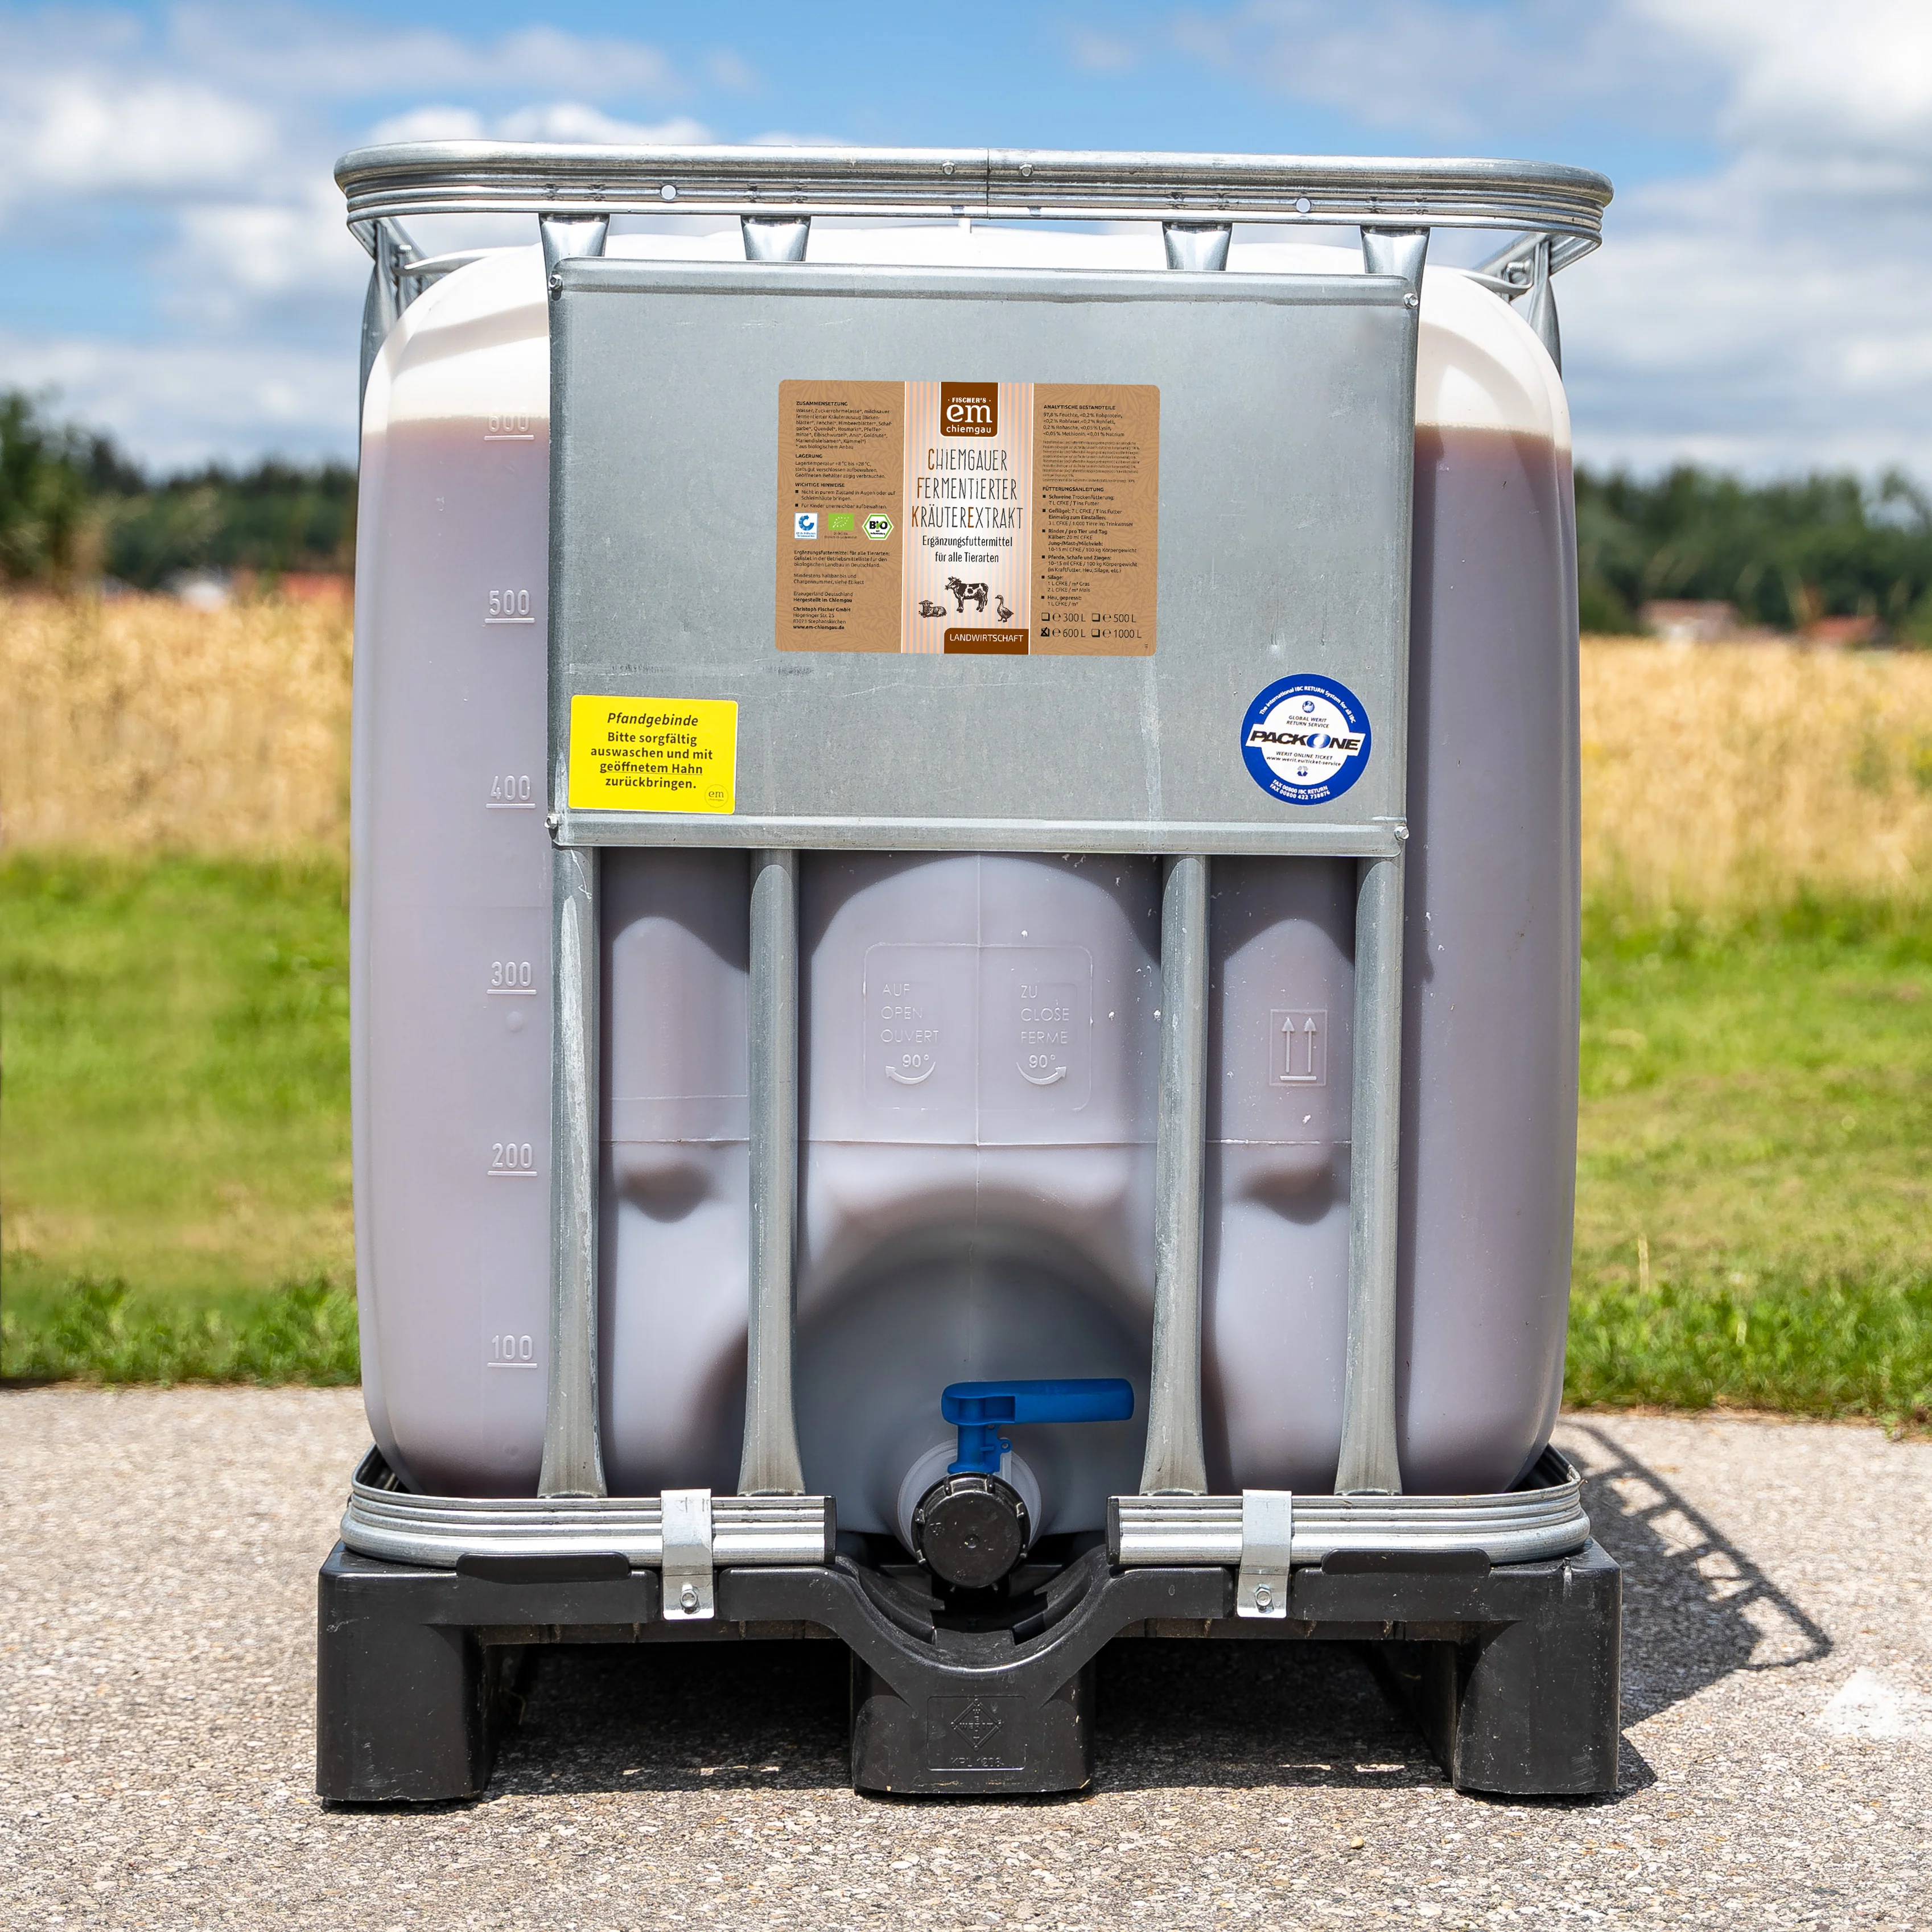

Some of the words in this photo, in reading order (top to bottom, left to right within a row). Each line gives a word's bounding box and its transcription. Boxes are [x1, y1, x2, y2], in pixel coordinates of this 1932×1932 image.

[946, 404, 992, 423] em
[946, 425, 991, 434] chiemgau
[912, 504, 1023, 529] KRÄUTEREXTRAKT
[922, 535, 1012, 547] Ergänzungsfuttermittel
[936, 551, 946, 562] für
[949, 552, 962, 562] alle
[965, 552, 999, 562] Tierarten
[488, 589, 530, 616] 500
[1063, 613, 1079, 622] 300
[1081, 613, 1086, 622] L
[1114, 613, 1129, 623] 500
[1132, 614, 1136, 623] L
[1063, 629, 1078, 637] 600
[1081, 629, 1086, 637] L
[1114, 629, 1134, 638] 1000
[1266, 687, 1294, 707] International
[1325, 690, 1341, 703] System
[607, 712, 699, 727] Pfandgebinde
[608, 732, 636, 742] Bitte
[639, 733, 697, 747] sorgfältig
[1250, 730, 1360, 751] PACKONE
[591, 747, 663, 758] auswaschen
[667, 749, 689, 759] und
[693, 749, 713, 760] mit
[600, 762, 668, 773] geöffnetem
[672, 764, 703, 774] Hahn
[490, 775, 532, 801] 400
[605, 777, 697, 790] zurückbringen.
[1282, 785, 1297, 793] 00800
[1308, 785, 1328, 794] RETURN
[1270, 784, 1280, 792] FAX
[1280, 790, 1296, 798] 00800
[1310, 790, 1330, 799] 738876
[491, 961, 533, 987] 300
[882, 983, 910, 996] AUF
[1020, 985, 1037, 998] ZU
[880, 1006, 922, 1019] OPEN
[1020, 1007, 1069, 1021] CLOSE
[880, 1029, 939, 1043] OUVERT
[902, 1054, 929, 1068] 90°
[1029, 1054, 1056, 1068] 90°
[492, 1143, 533, 1169] 200
[491, 1334, 533, 1361] 100
